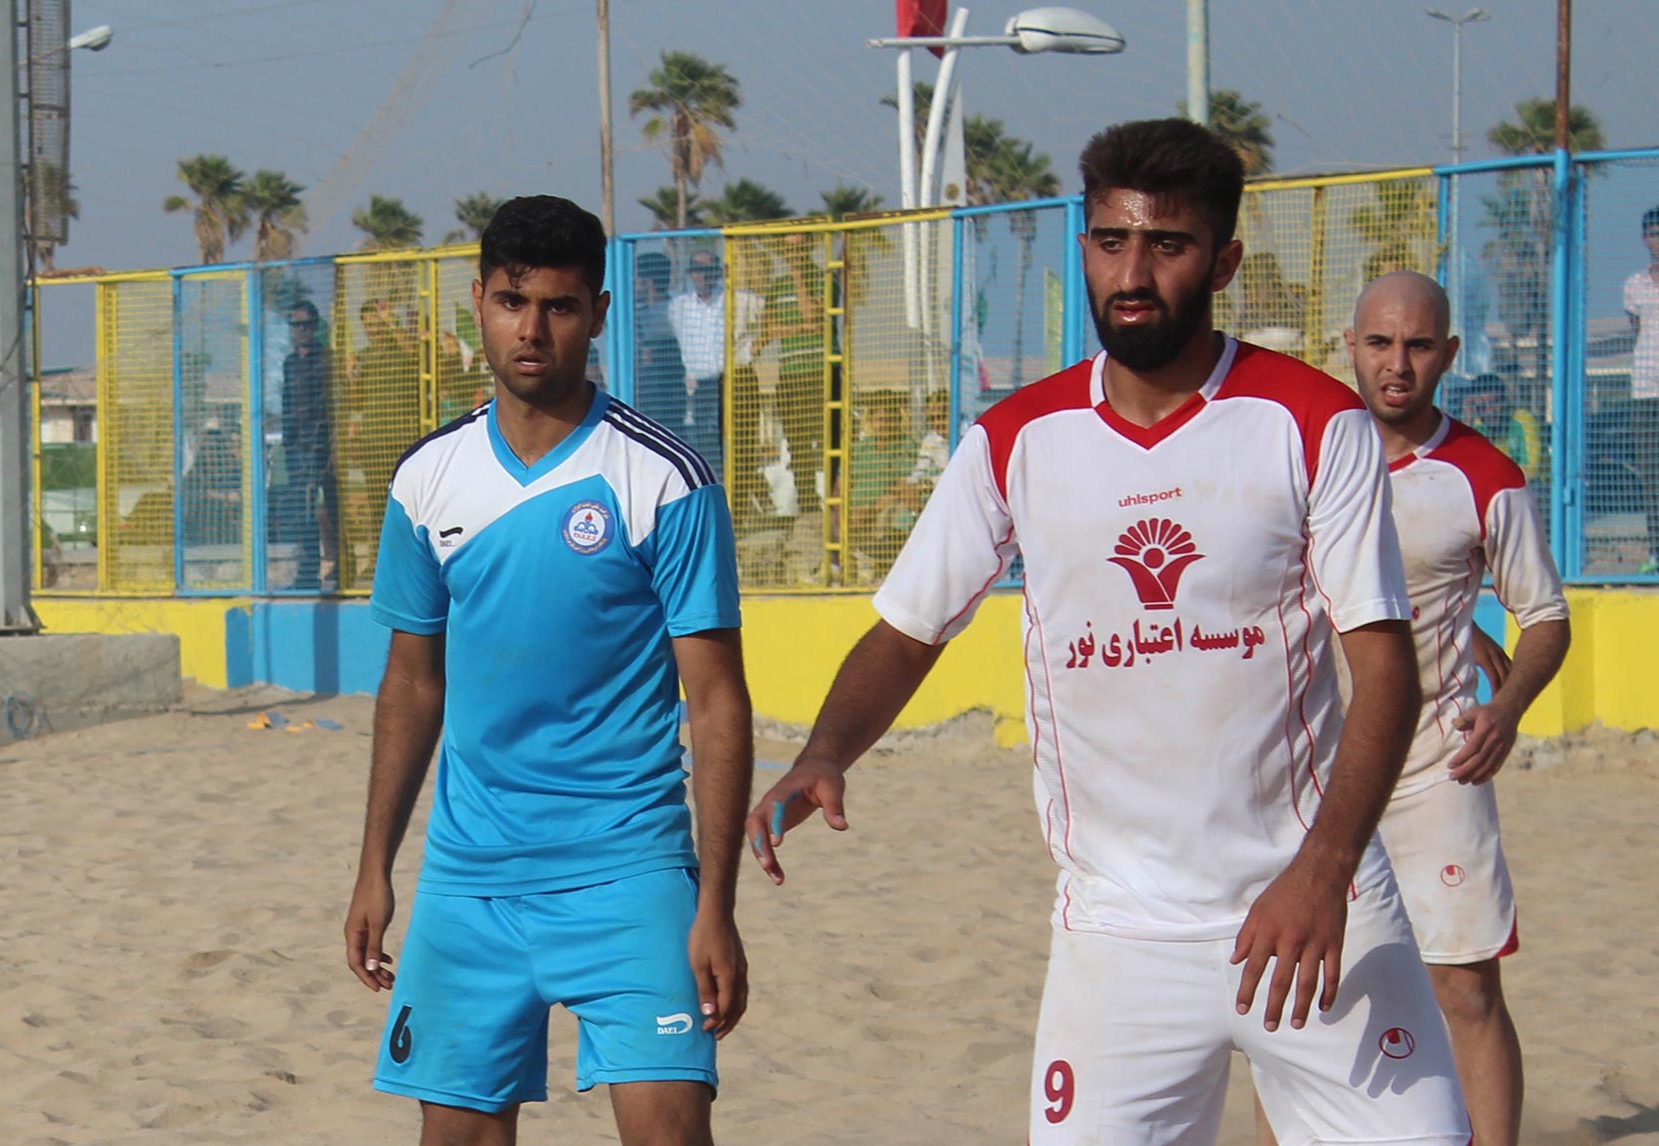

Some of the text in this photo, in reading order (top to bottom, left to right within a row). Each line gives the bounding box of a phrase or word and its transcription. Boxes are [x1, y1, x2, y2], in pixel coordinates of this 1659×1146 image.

[1118, 487, 1182, 508] uhlsport
[1065, 616, 1265, 669] موسسه اعتباری نور
[389, 1005, 412, 1064] 6
[1044, 1060, 1075, 1124] 9
